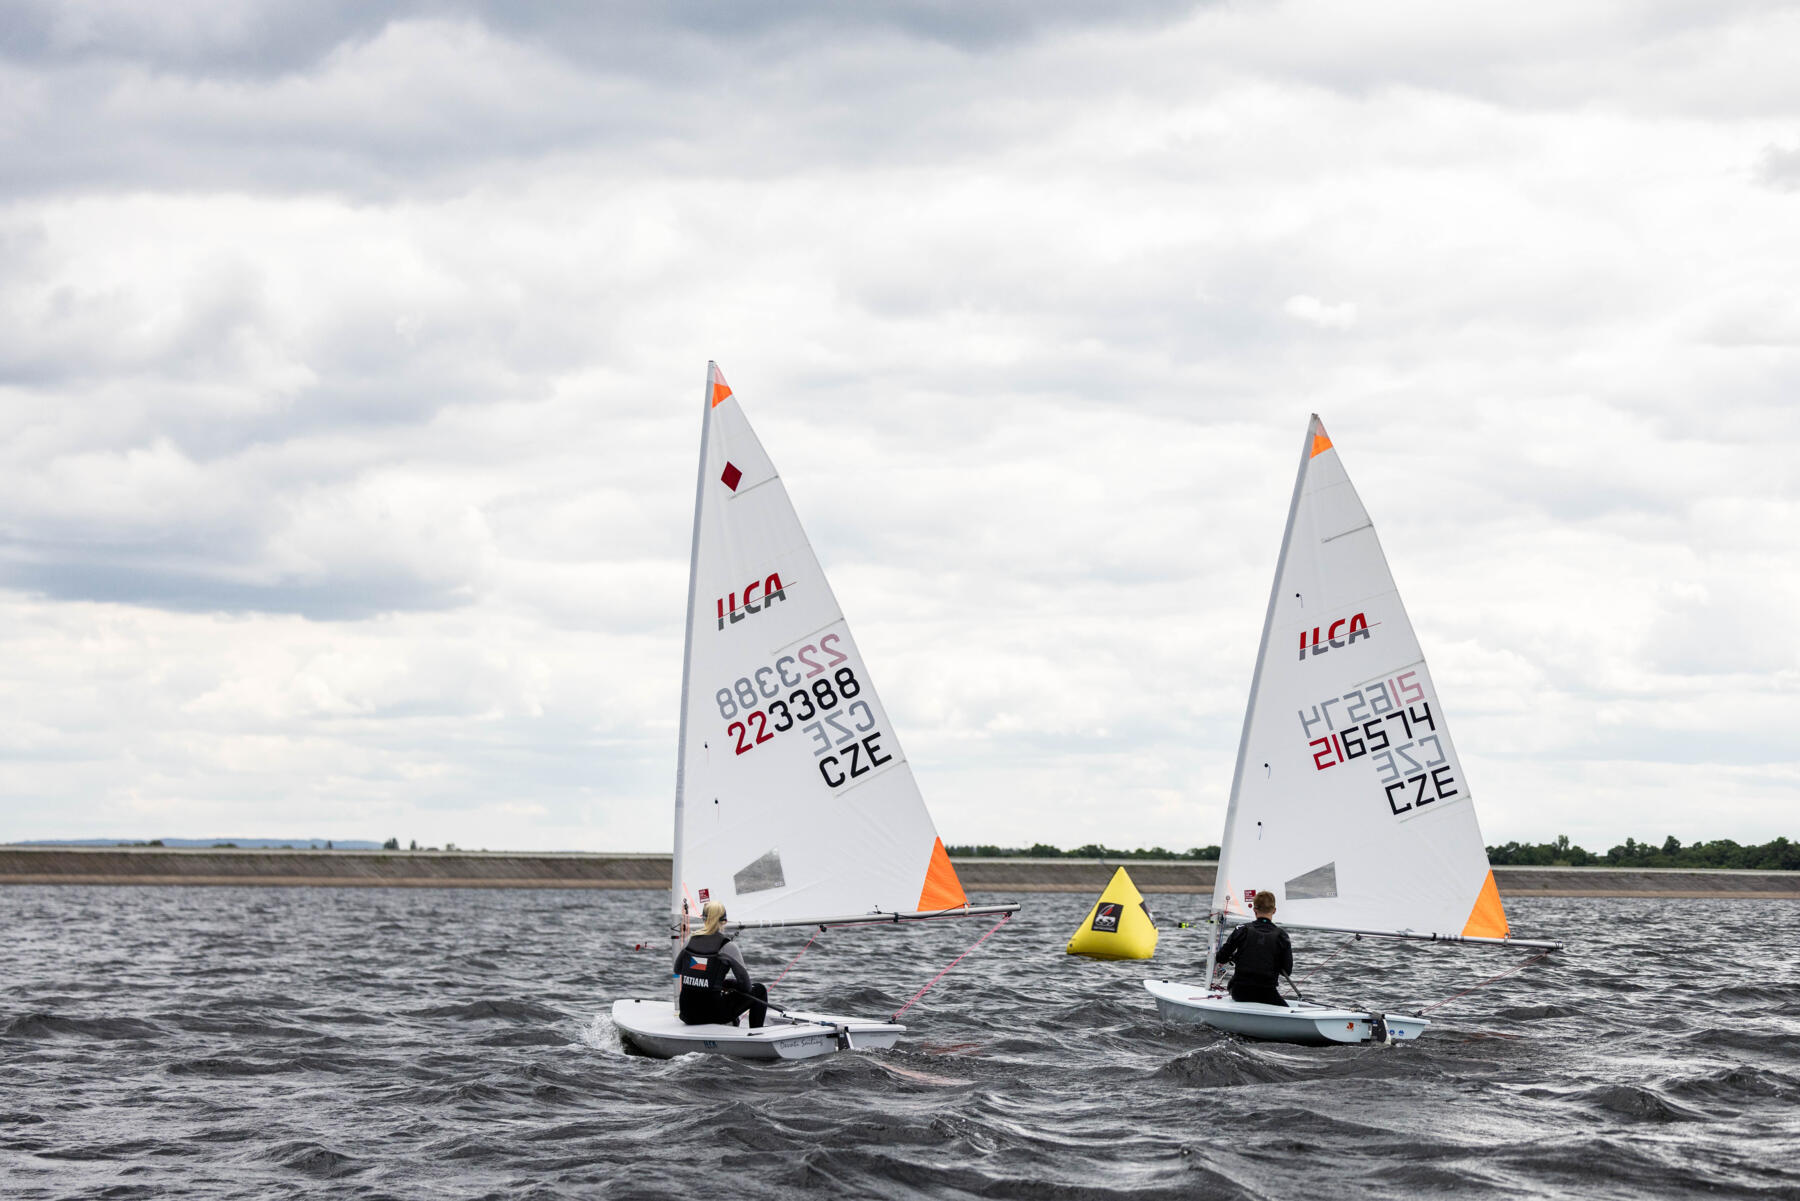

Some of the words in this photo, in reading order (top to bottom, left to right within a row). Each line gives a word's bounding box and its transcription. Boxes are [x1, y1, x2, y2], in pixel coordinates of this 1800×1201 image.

[717, 572, 787, 631] ILCA
[1299, 612, 1371, 661] ILCA
[727, 667, 861, 756] 223388
[1309, 702, 1436, 771] 216574
[819, 732, 892, 788] CZE
[1385, 765, 1458, 815] CZE
[683, 975, 709, 988] TATIANA
